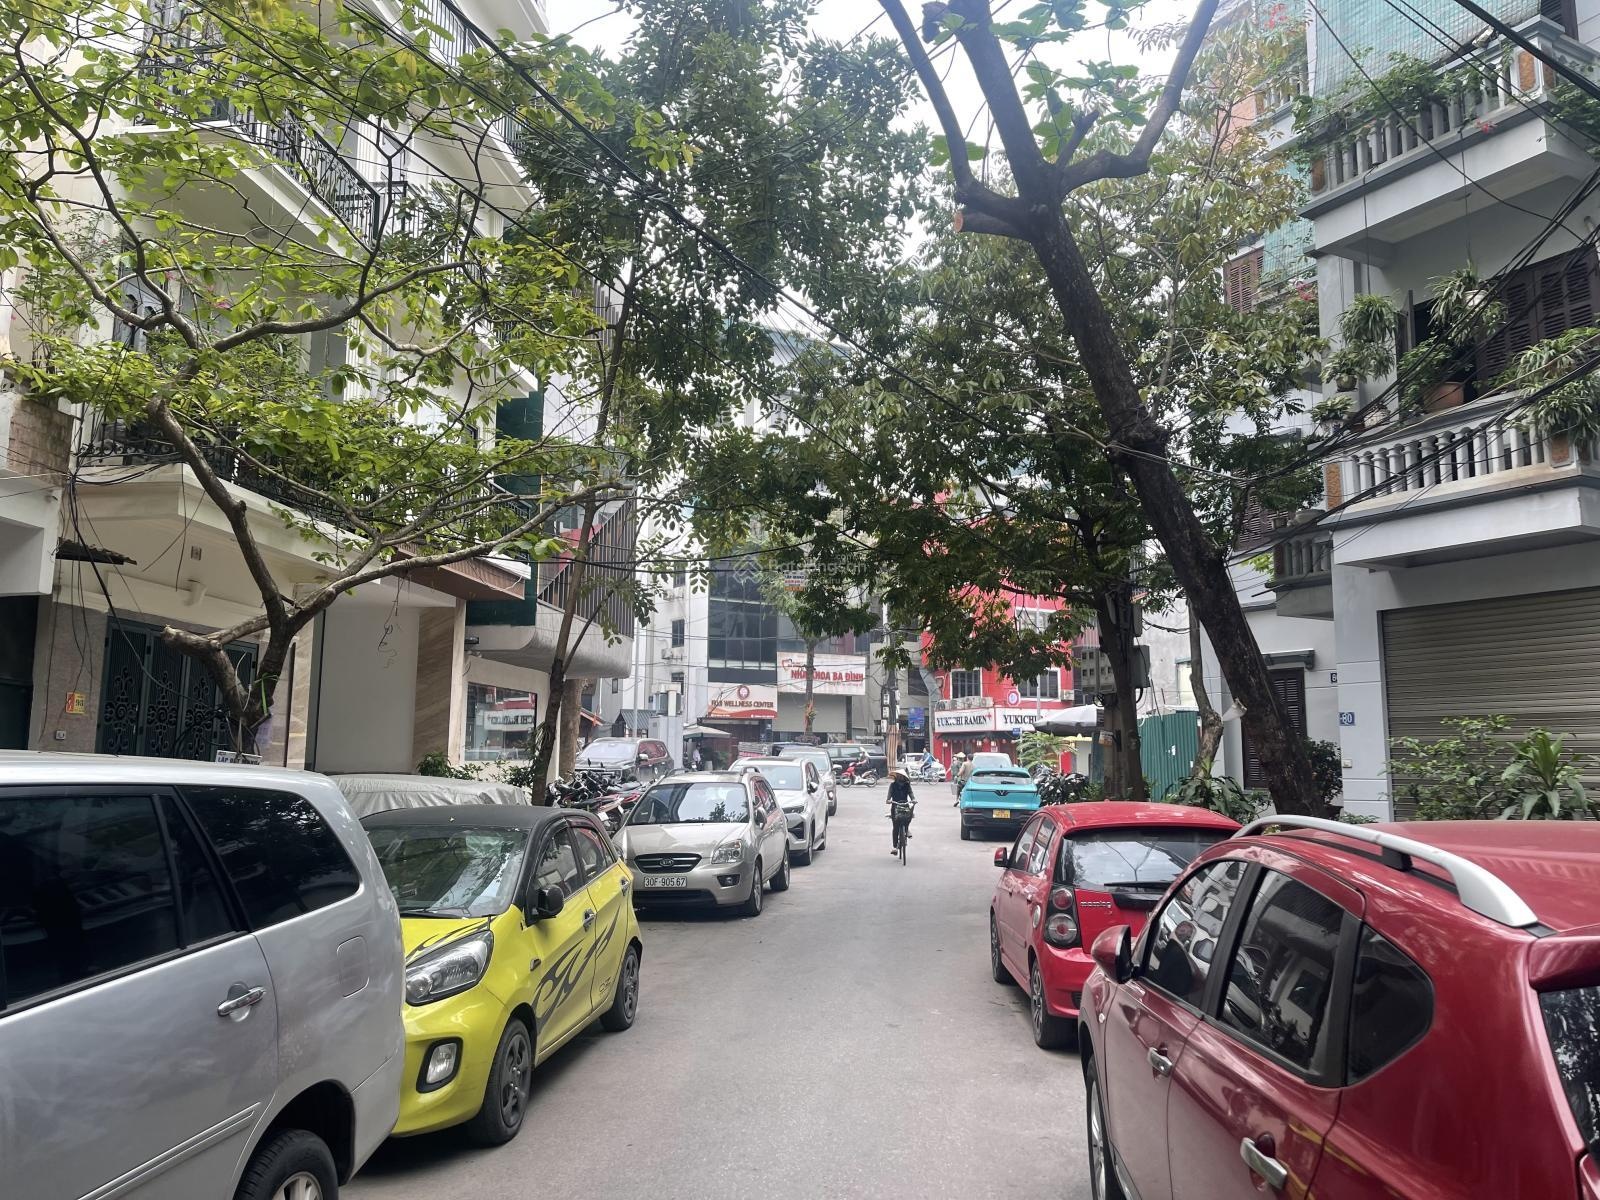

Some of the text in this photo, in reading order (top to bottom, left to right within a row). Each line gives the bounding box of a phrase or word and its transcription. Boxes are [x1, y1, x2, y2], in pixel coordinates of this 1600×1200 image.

[833, 671, 843, 681] BA
[723, 700, 753, 708] WELLNESS
[964, 714, 987, 726] RAMEN
